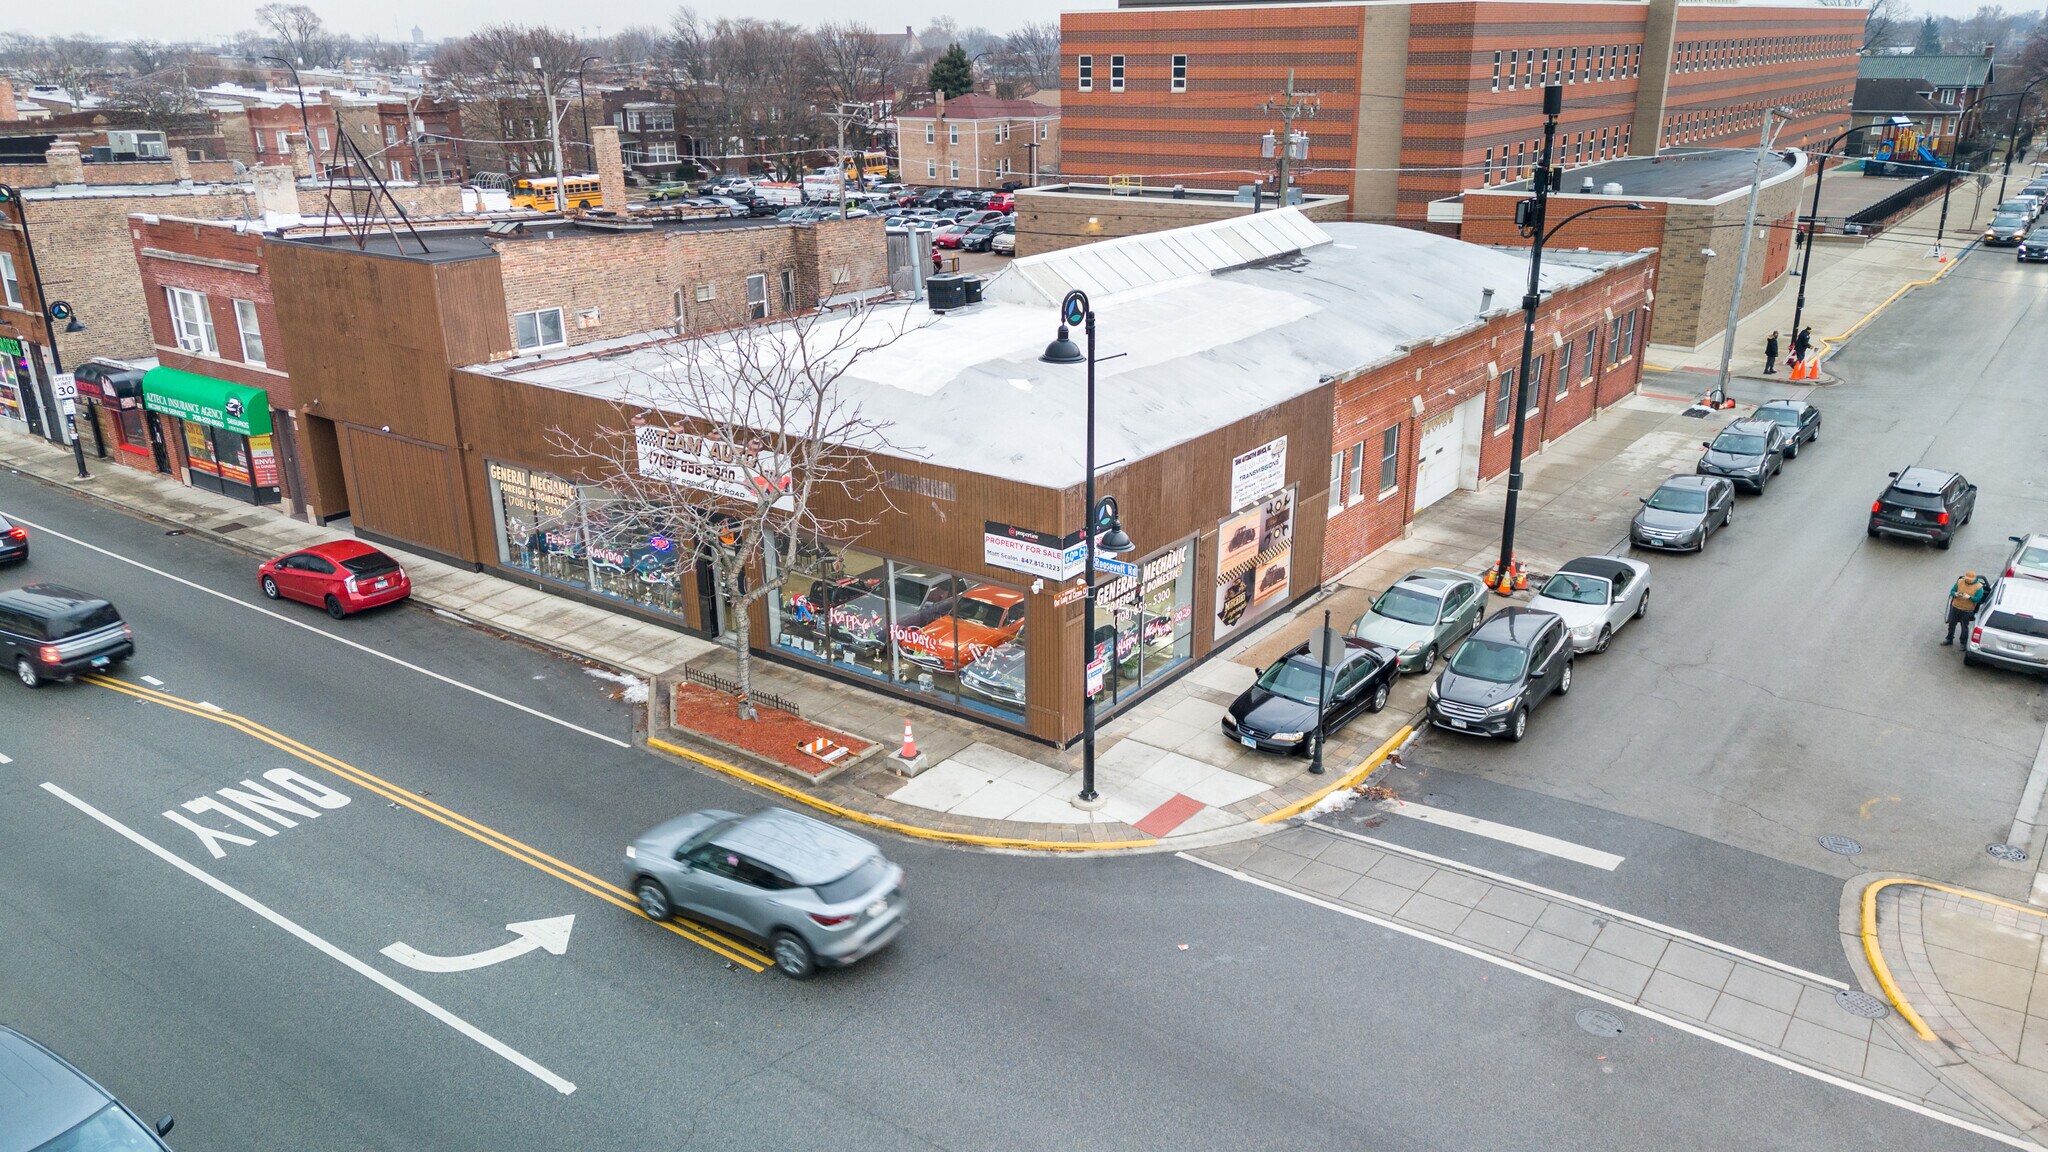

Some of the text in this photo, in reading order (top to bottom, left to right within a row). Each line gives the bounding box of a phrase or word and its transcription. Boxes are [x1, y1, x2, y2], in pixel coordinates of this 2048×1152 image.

[58, 386, 75, 396] 30
[146, 392, 224, 420] AZTECA INSURANCE AGENCY
[655, 430, 703, 457] TEAM
[490, 464, 574, 500] GENERAL MECHANIC
[1239, 459, 1279, 482] TRANSMISSIONS
[500, 481, 568, 508] FOREIGN & DOMESTIC
[681, 478, 724, 492] ROOSEVELT
[724, 488, 746, 498] ROAD
[508, 495, 527, 510] (708)
[985, 536, 1024, 551] PROPERTY
[1025, 545, 1041, 555] FOR
[1042, 549, 1062, 560] SALE
[986, 549, 1000, 557] Matt
[1000, 552, 1019, 562] Scales
[1021, 557, 1060, 572] 847.812.1223
[1064, 550, 1079, 563] 60th
[1094, 556, 1126, 574] Roosevelt
[1128, 565, 1138, 576] Rd
[1096, 545, 1187, 607] GENERAL MECHANIC
[1105, 589, 1137, 615] FOREIGN
[1146, 564, 1183, 593] DOMESTIC
[829, 607, 868, 634] HAPPY
[161, 767, 352, 859] ONLY
